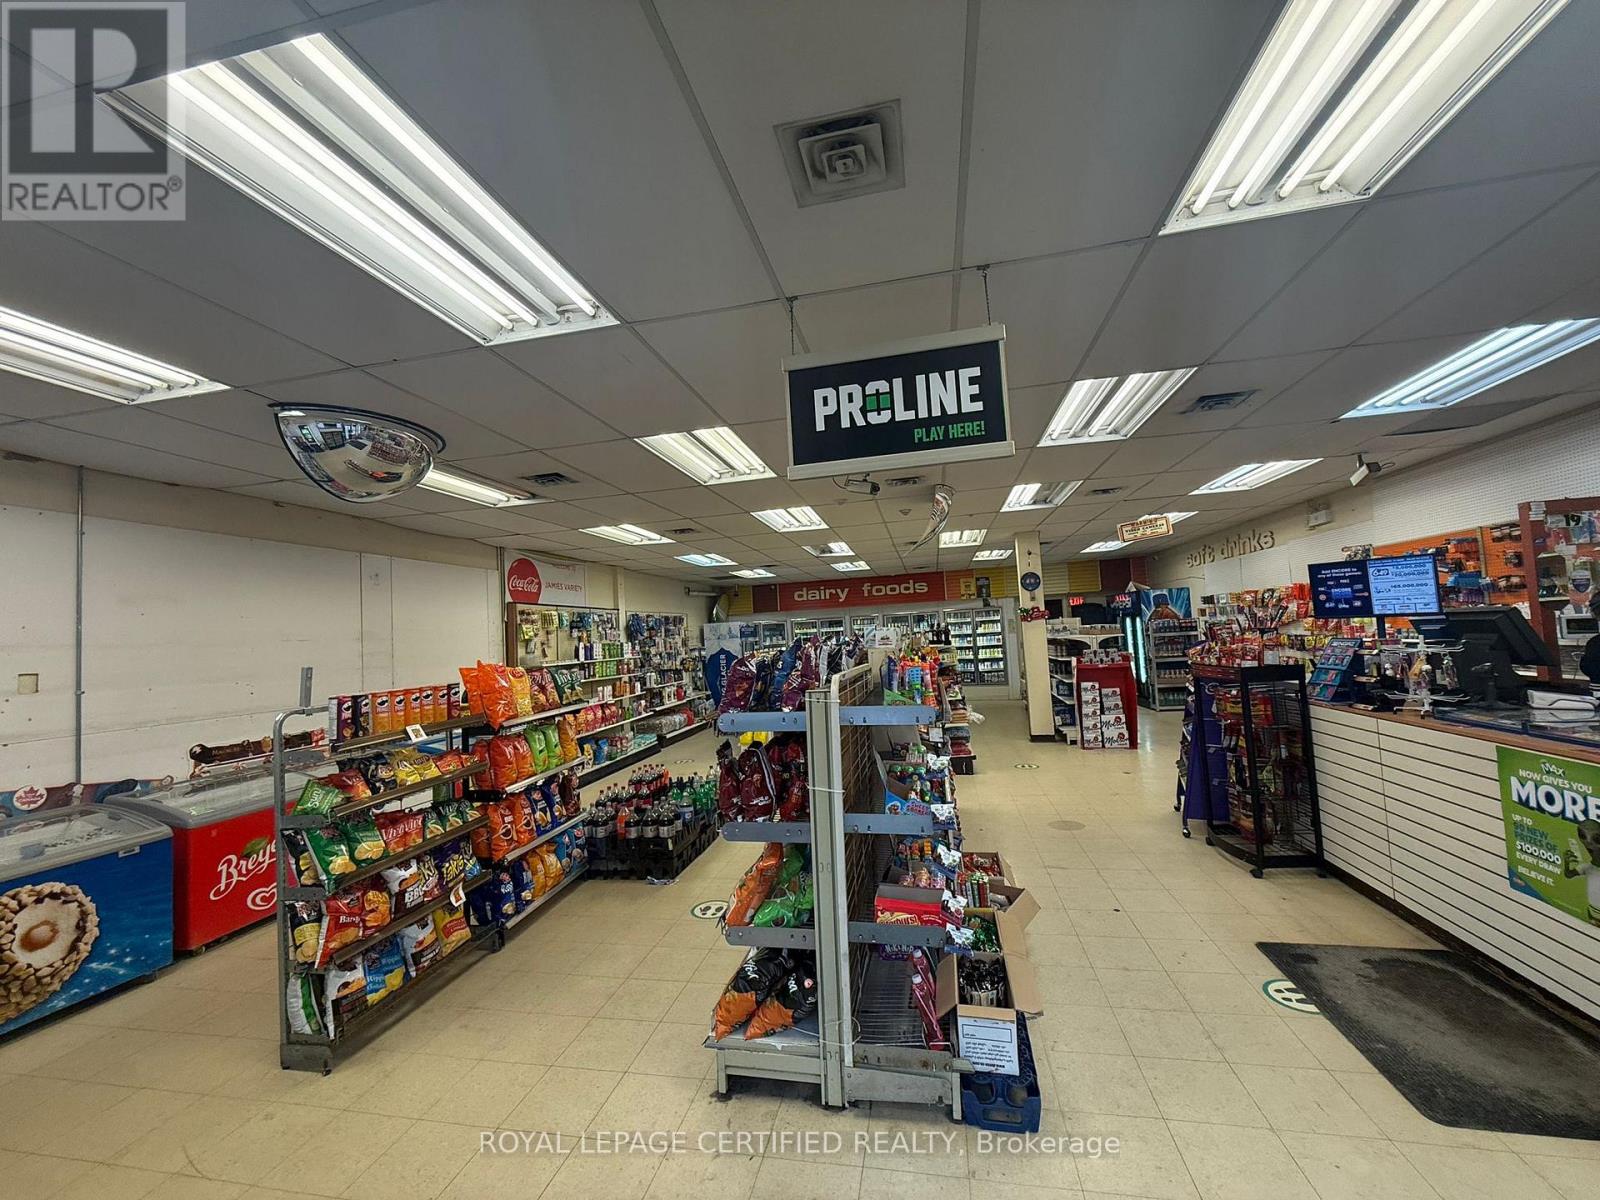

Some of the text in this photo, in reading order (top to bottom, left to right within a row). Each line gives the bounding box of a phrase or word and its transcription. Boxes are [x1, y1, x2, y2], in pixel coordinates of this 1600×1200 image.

[813, 366, 984, 432] PROLINE
[914, 420, 985, 444] PLAY HERE!
[1186, 528, 1275, 568] soft drinks
[793, 579, 929, 602] dairy foods
[1519, 768, 1593, 795] NOW GIVES YOU
[1510, 776, 1600, 823] MORE
[1511, 813, 1533, 826] UP TO
